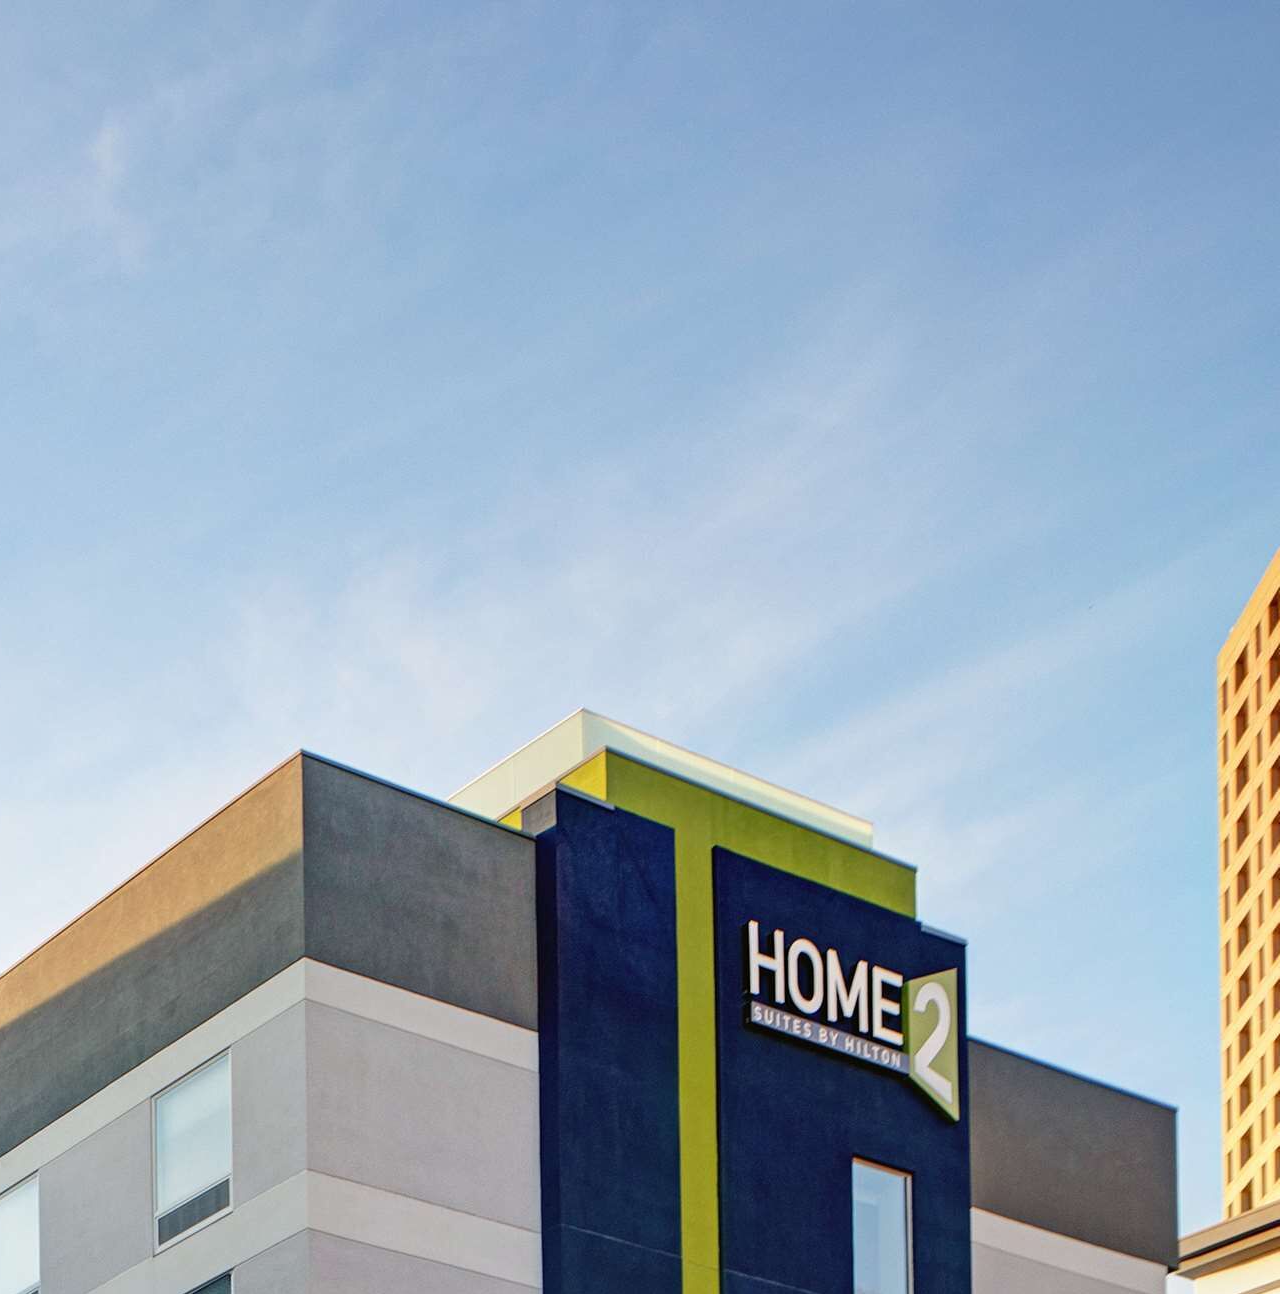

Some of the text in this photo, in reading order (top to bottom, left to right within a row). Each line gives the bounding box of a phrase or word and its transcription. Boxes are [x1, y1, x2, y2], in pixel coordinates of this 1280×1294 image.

[748, 919, 954, 1104] HOME 2
[753, 1005, 902, 1068] SUITES BY HILTON
